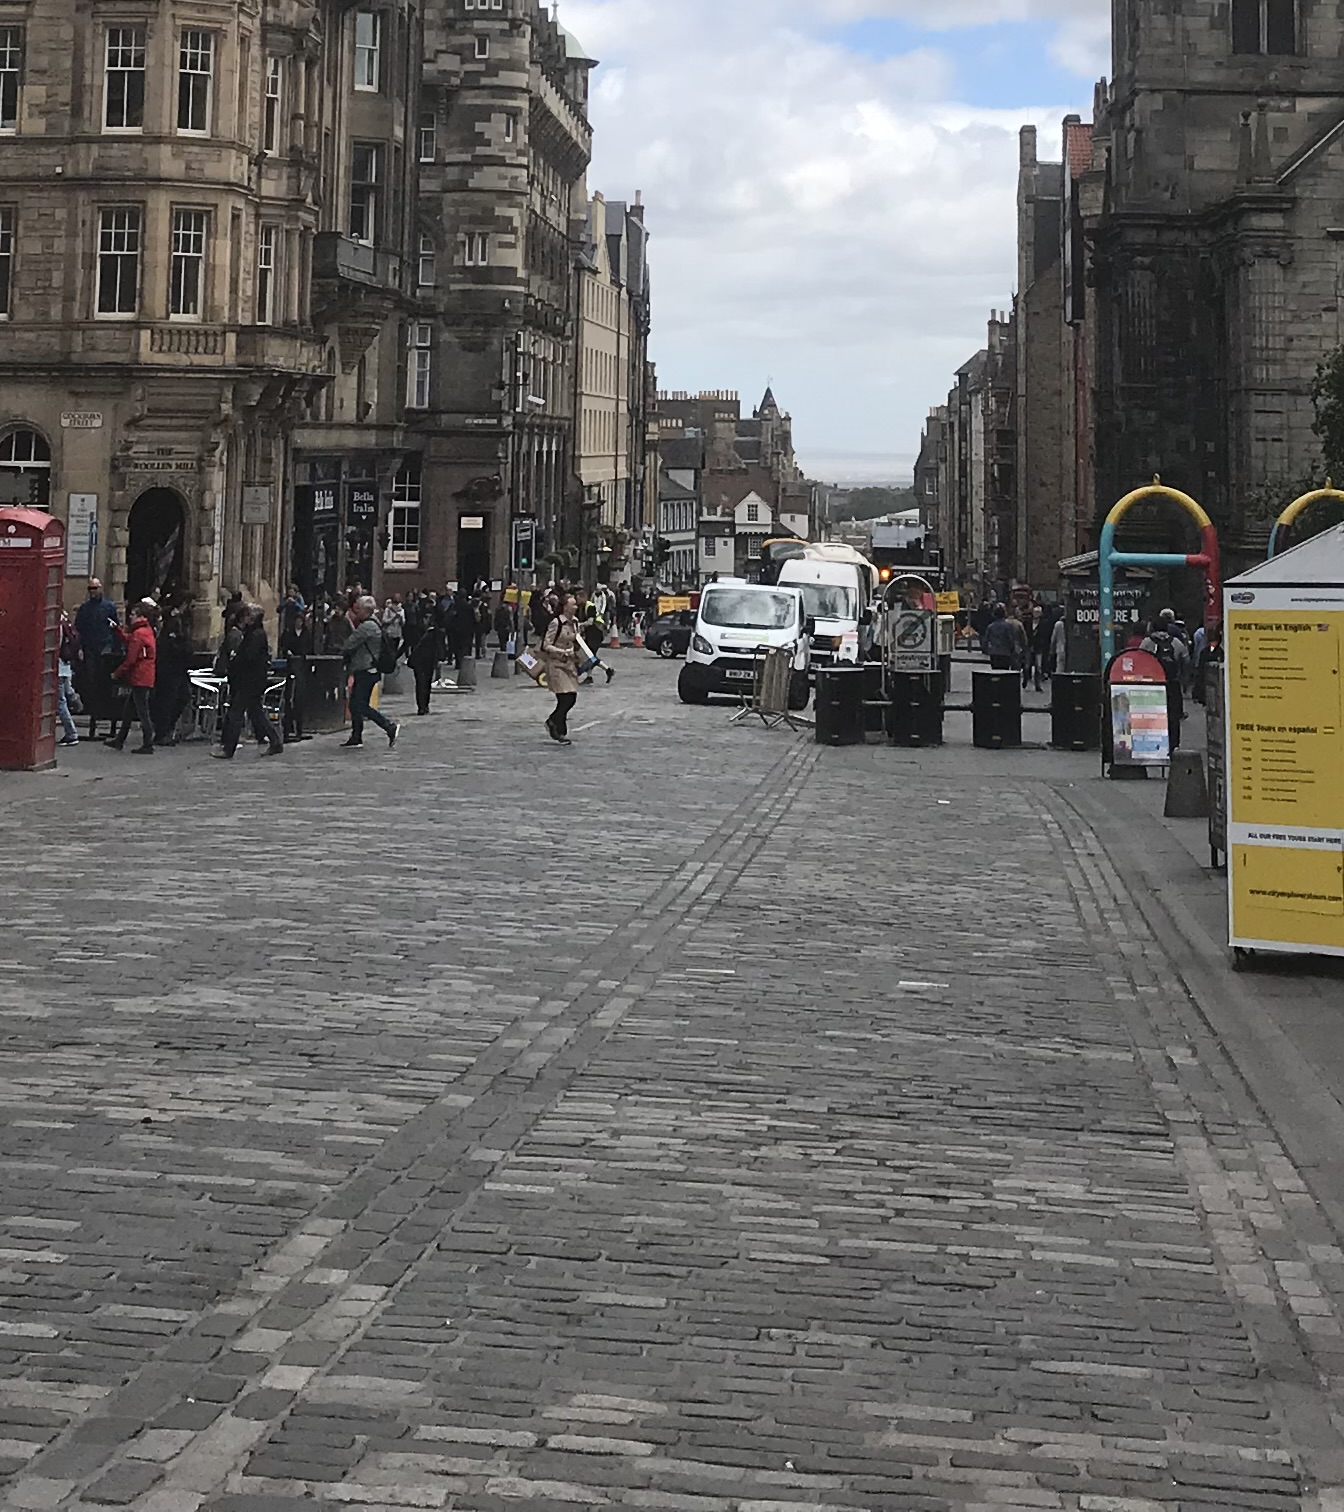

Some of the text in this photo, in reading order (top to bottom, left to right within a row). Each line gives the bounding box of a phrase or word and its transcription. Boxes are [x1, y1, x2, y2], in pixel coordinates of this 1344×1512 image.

[353, 491, 374, 502] Bella
[353, 503, 375, 513] Italia
[1076, 609, 1100, 622] BOO
[1234, 622, 1253, 630] FREE
[1254, 622, 1273, 631] Tours
[1282, 623, 1312, 633] English
[1236, 723, 1254, 731] FREE
[1256, 724, 1276, 732] Tours
